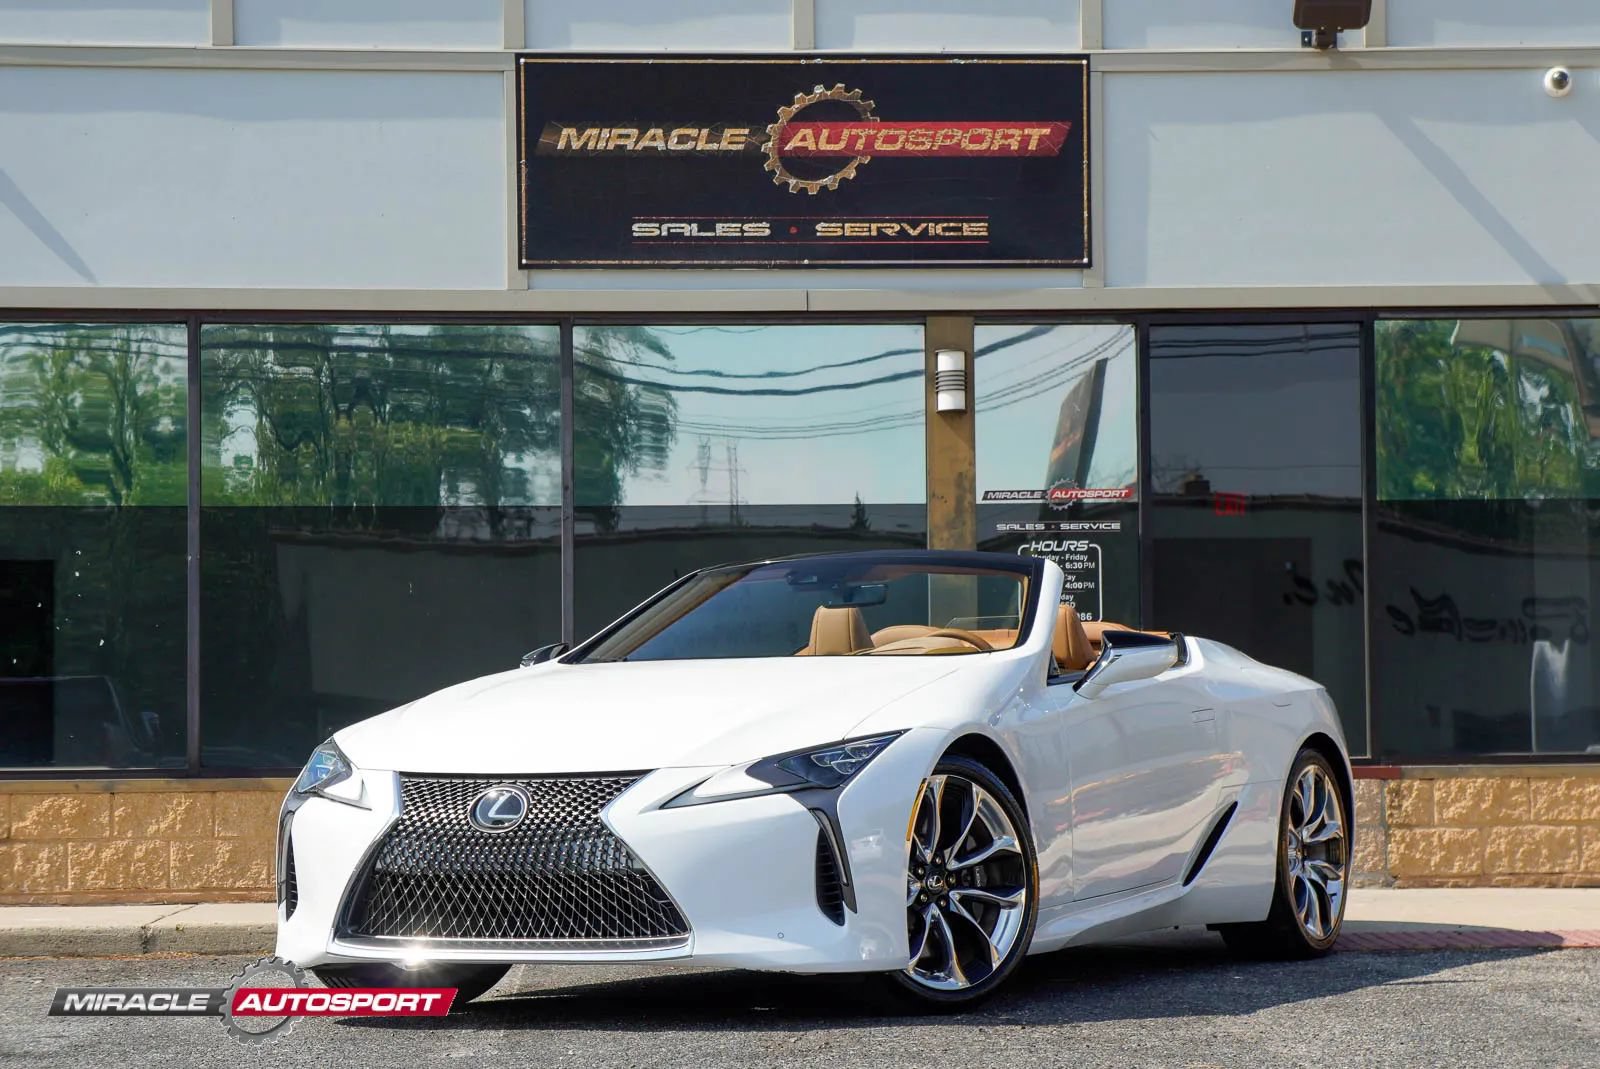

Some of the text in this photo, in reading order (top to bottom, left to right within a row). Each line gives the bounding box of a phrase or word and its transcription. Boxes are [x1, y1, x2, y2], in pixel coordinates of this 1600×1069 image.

[556, 127, 1051, 151] MIRACLE AUTOSPORT
[632, 222, 989, 237] SALES SERVICE
[987, 489, 1129, 499] MIRACLE AUTOSPORT
[996, 522, 1121, 531] SALES SERVICE
[1030, 540, 1090, 552] HOURS
[1065, 553, 1088, 562] Friday
